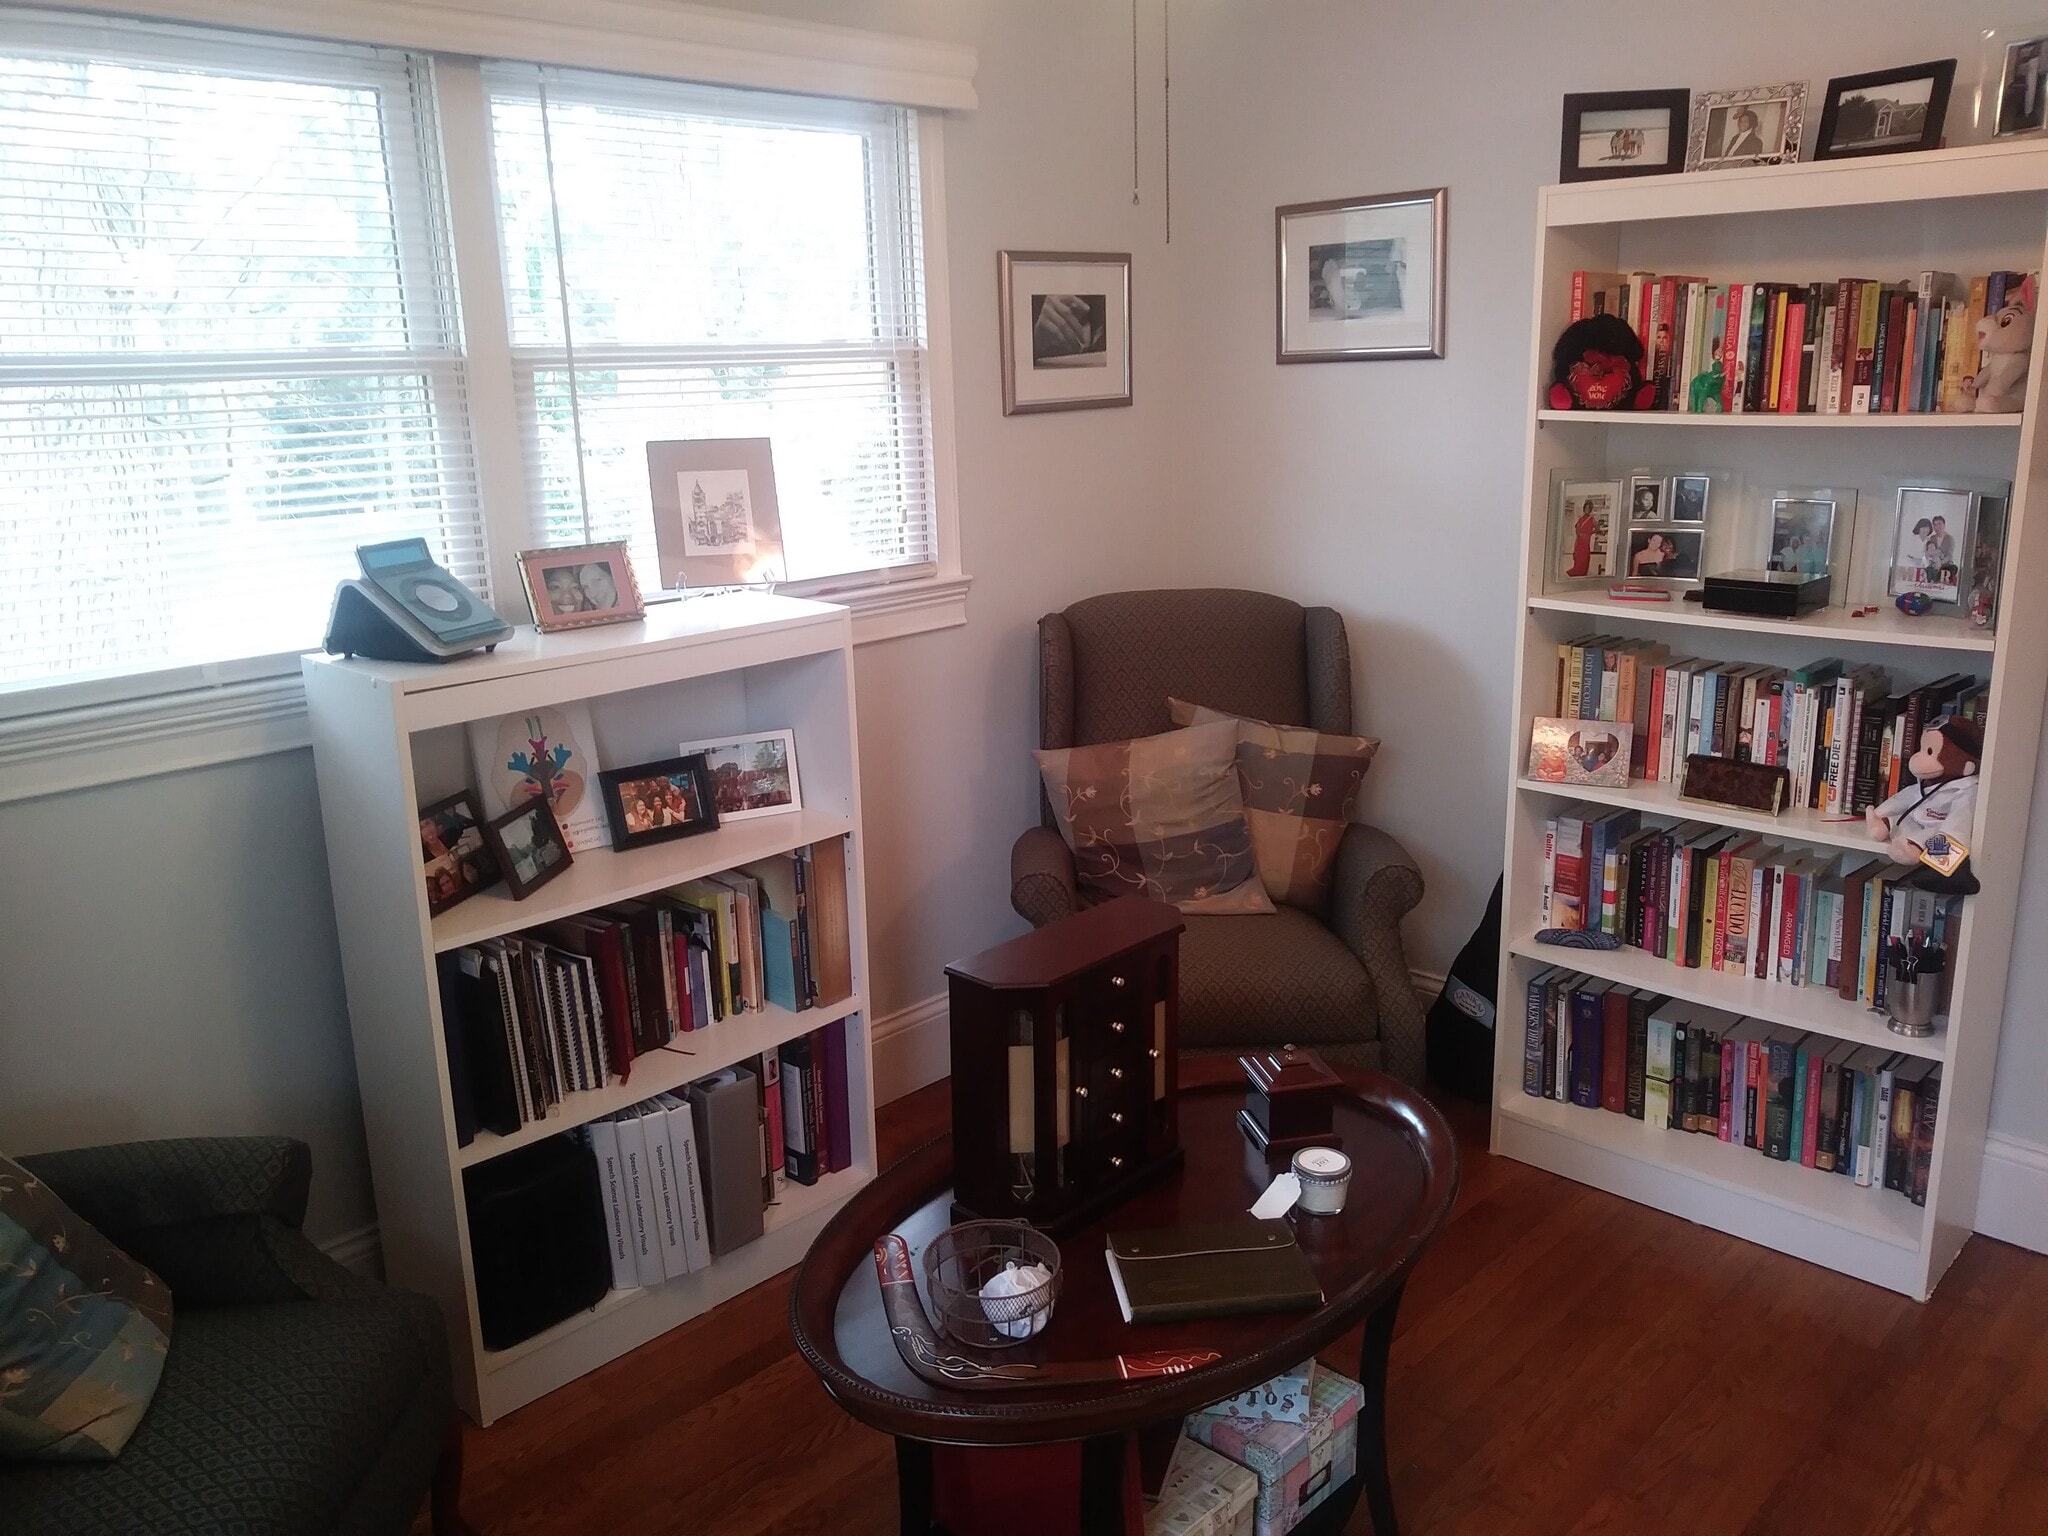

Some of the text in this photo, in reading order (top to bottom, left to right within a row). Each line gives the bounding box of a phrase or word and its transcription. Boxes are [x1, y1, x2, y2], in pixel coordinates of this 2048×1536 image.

[1729, 290, 1739, 315] SOPHIE
[1837, 291, 1848, 309] POWER
[1726, 317, 1737, 350] KINSELLA
[1835, 327, 1845, 345] GLORY
[1573, 652, 1581, 662] GET
[1572, 666, 1580, 678] OUT
[1572, 680, 1580, 688] OF
[1582, 653, 1595, 716] JODI PICOULT
[1571, 692, 1579, 706] THAT
[1908, 697, 1917, 715] WHY
[1716, 708, 1724, 723] FROM
[1831, 738, 1841, 760] DIET
[1903, 722, 1914, 754] BELIEVE
[1545, 833, 1554, 859] Quitter
[1752, 879, 1760, 897] Next
[1729, 889, 1747, 935] LUCADO
[1881, 897, 1890, 926] Battlefield
[1783, 911, 1792, 954] ARRANGED
[1528, 994, 1540, 1027] MAKER'S
[1527, 1028, 1539, 1050] DIET
[1748, 1042, 1759, 1059] Nanny
[656, 1145, 676, 1247] Speech Science Laboratory Visuals
[683, 1139, 701, 1241] Speech Science Laboratory Visuals
[606, 1156, 626, 1260] Speech Science Laboratory Visuals
[629, 1153, 649, 1256] Speech Science Laboratory Visuals
